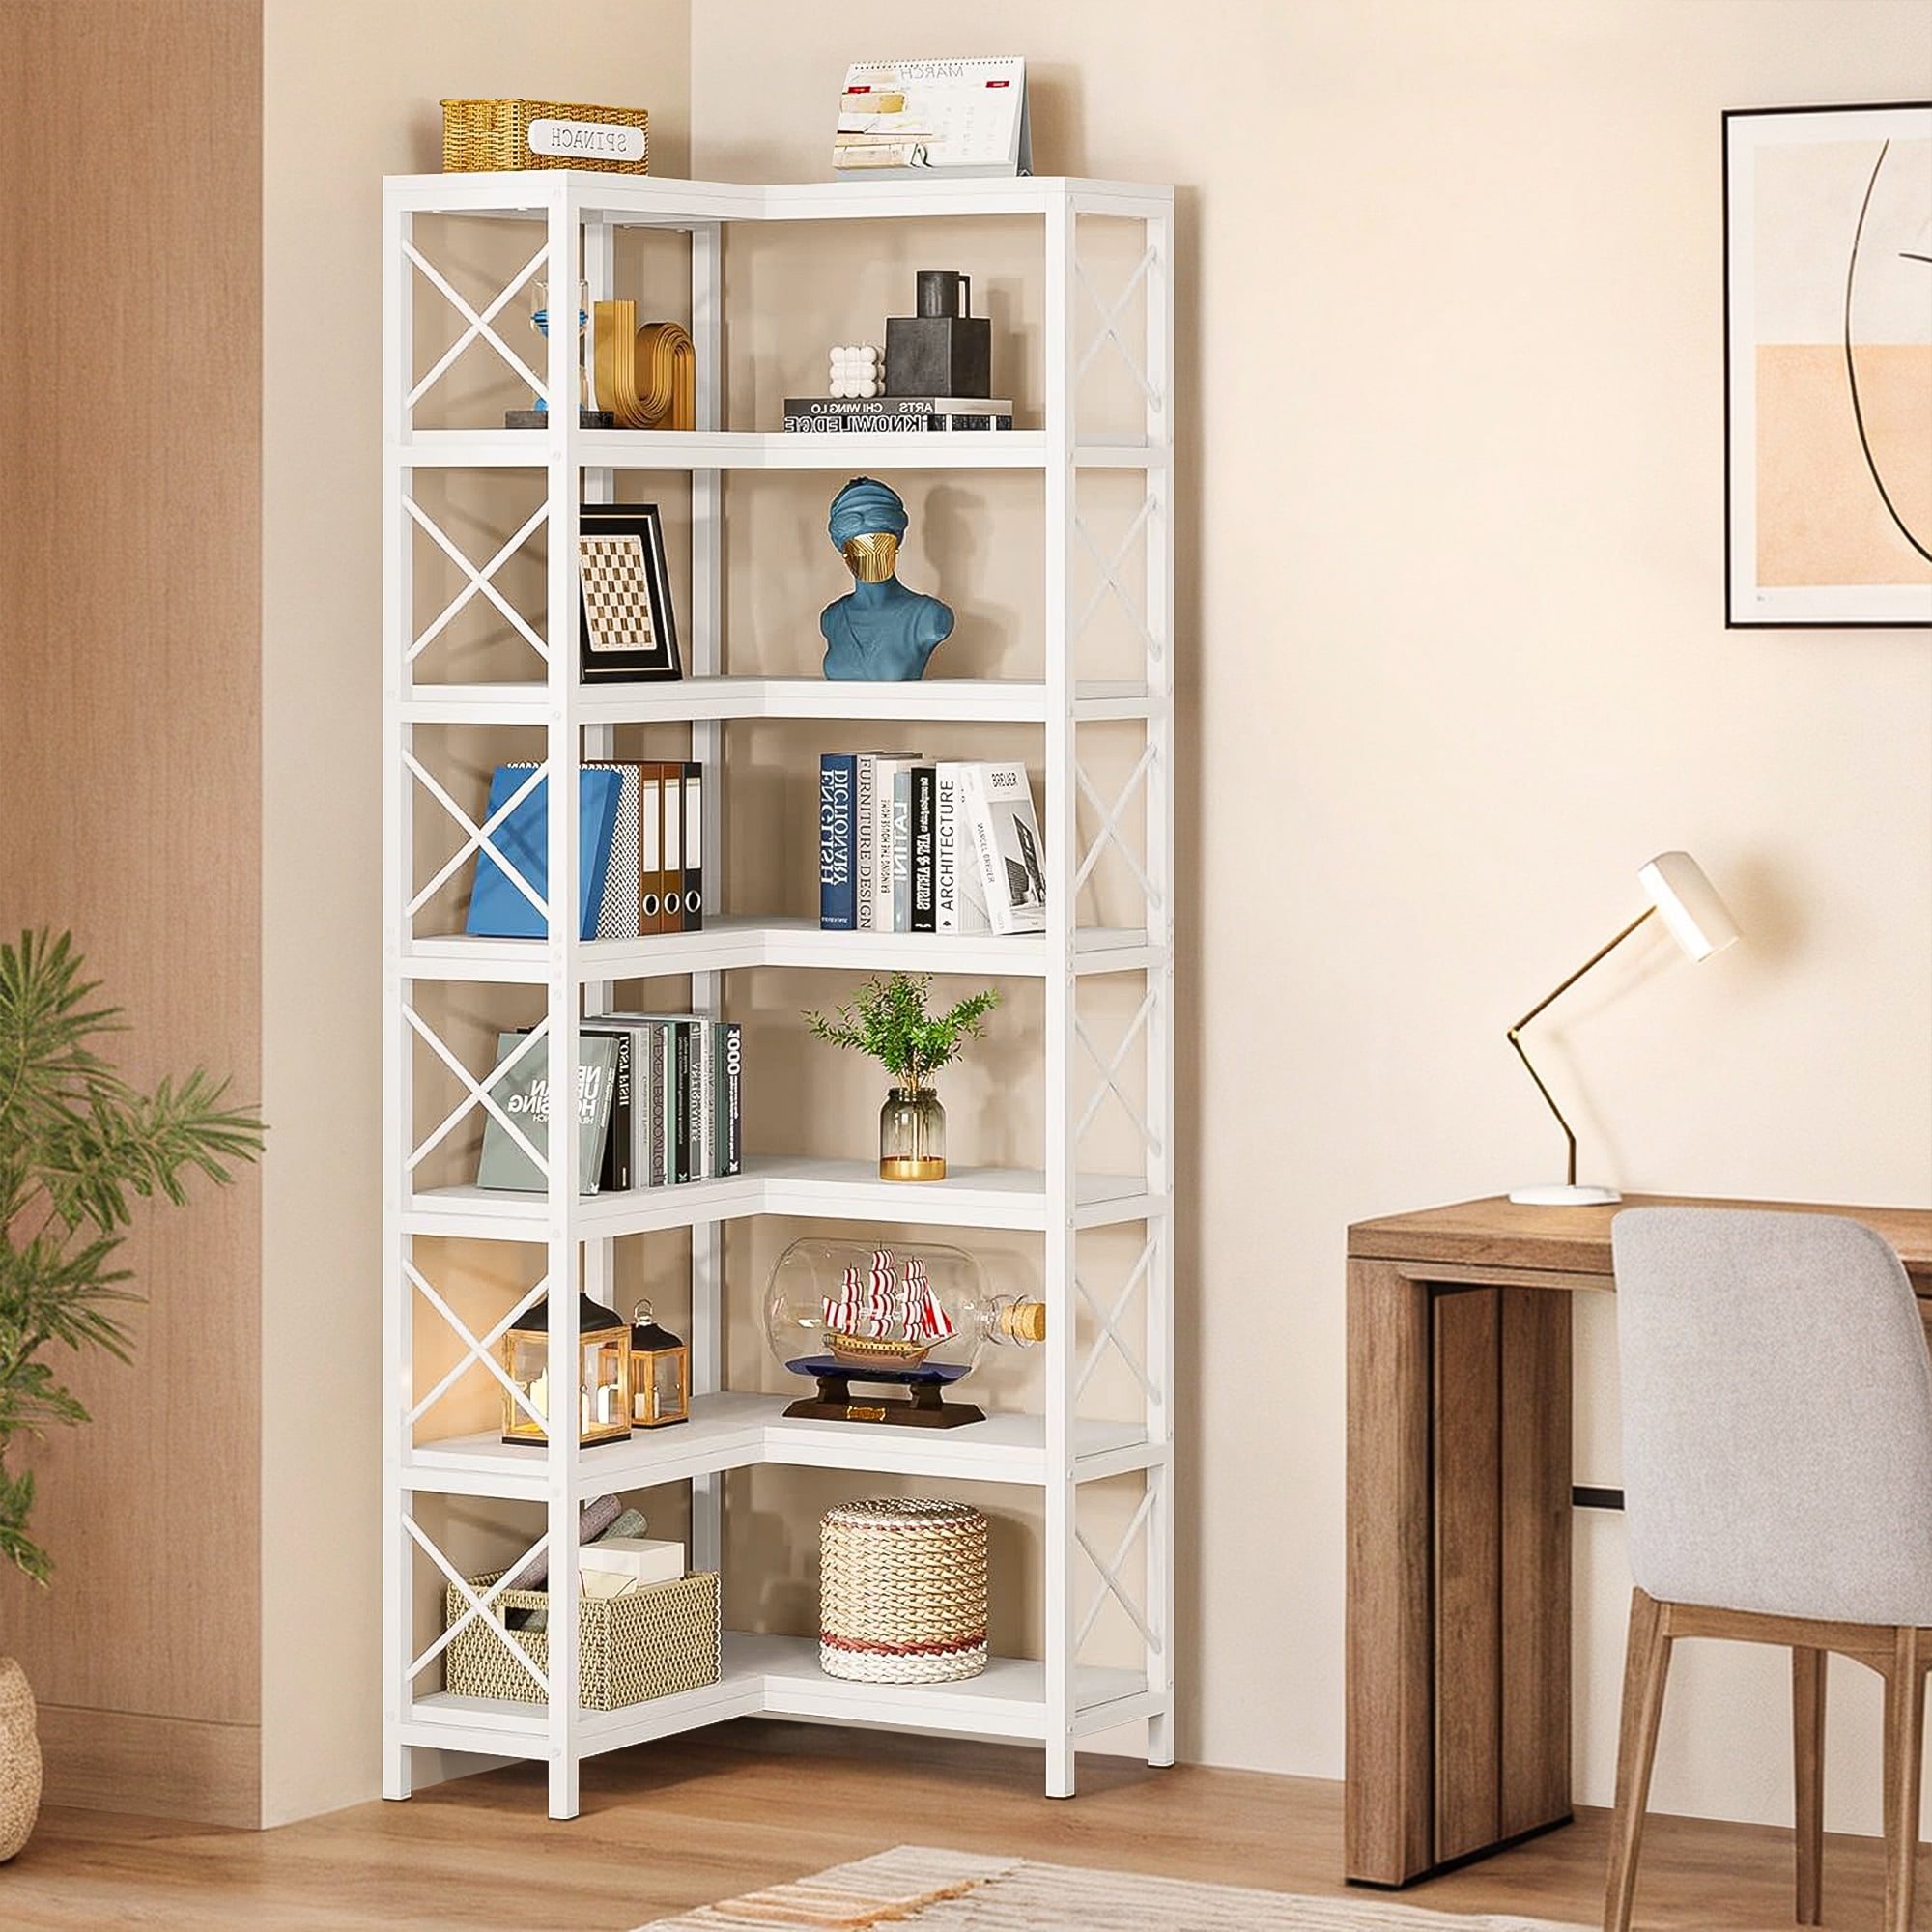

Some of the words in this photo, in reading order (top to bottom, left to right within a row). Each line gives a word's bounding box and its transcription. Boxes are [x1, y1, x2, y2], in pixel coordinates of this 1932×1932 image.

[860, 757, 872, 860] FURNITURE
[940, 780, 954, 912] ARCHITECTURE
[860, 865, 872, 929] DESIGN
